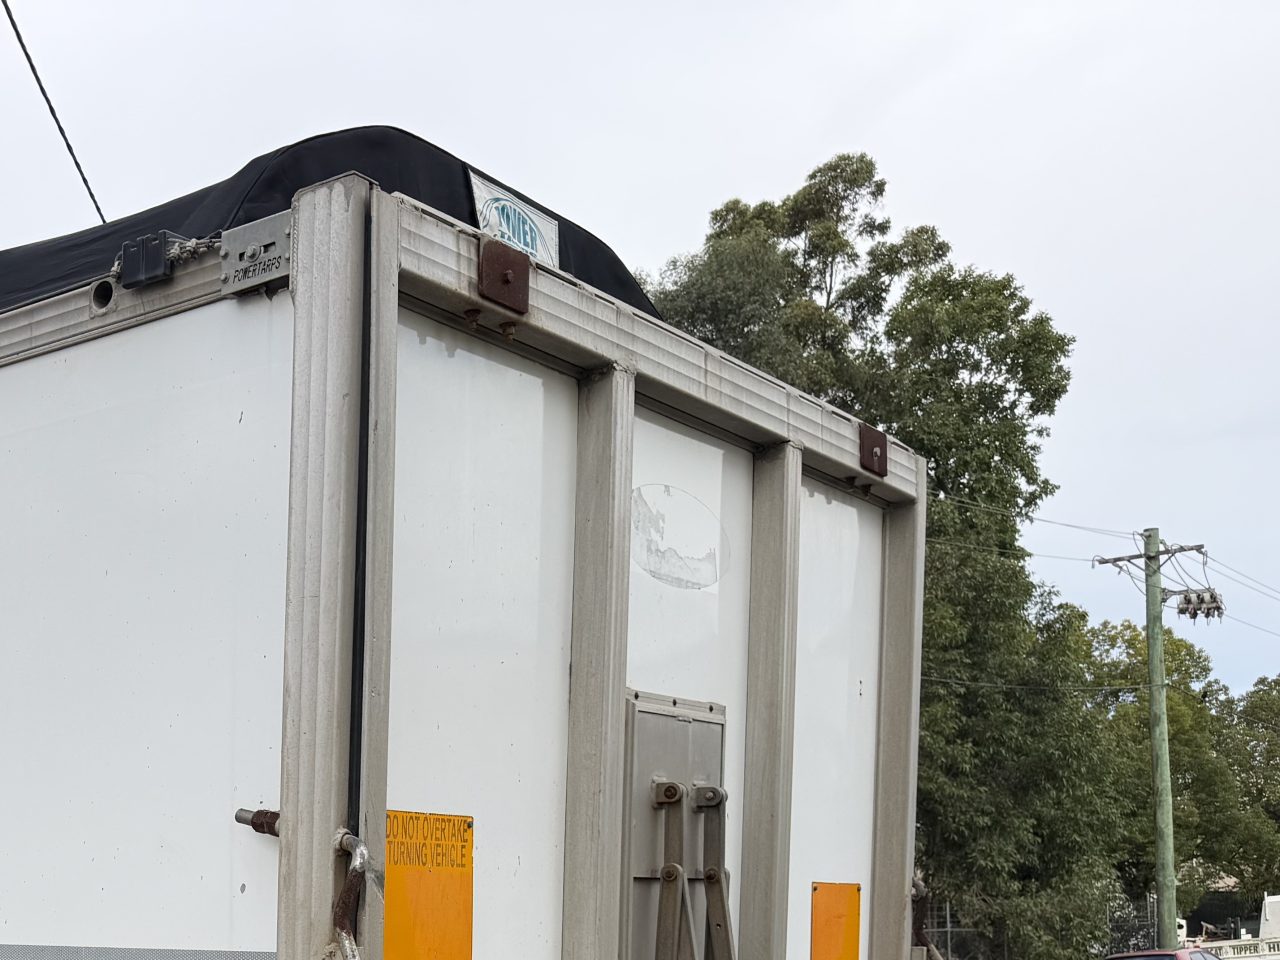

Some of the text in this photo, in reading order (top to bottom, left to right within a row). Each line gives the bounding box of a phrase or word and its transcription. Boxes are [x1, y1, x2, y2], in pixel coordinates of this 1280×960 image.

[233, 256, 282, 284] POWERTARPS
[386, 814, 468, 843] DO NOT OVERTAKE
[387, 841, 466, 868] TURNING VEHICLE
[1231, 945, 1259, 956] TIPPER
